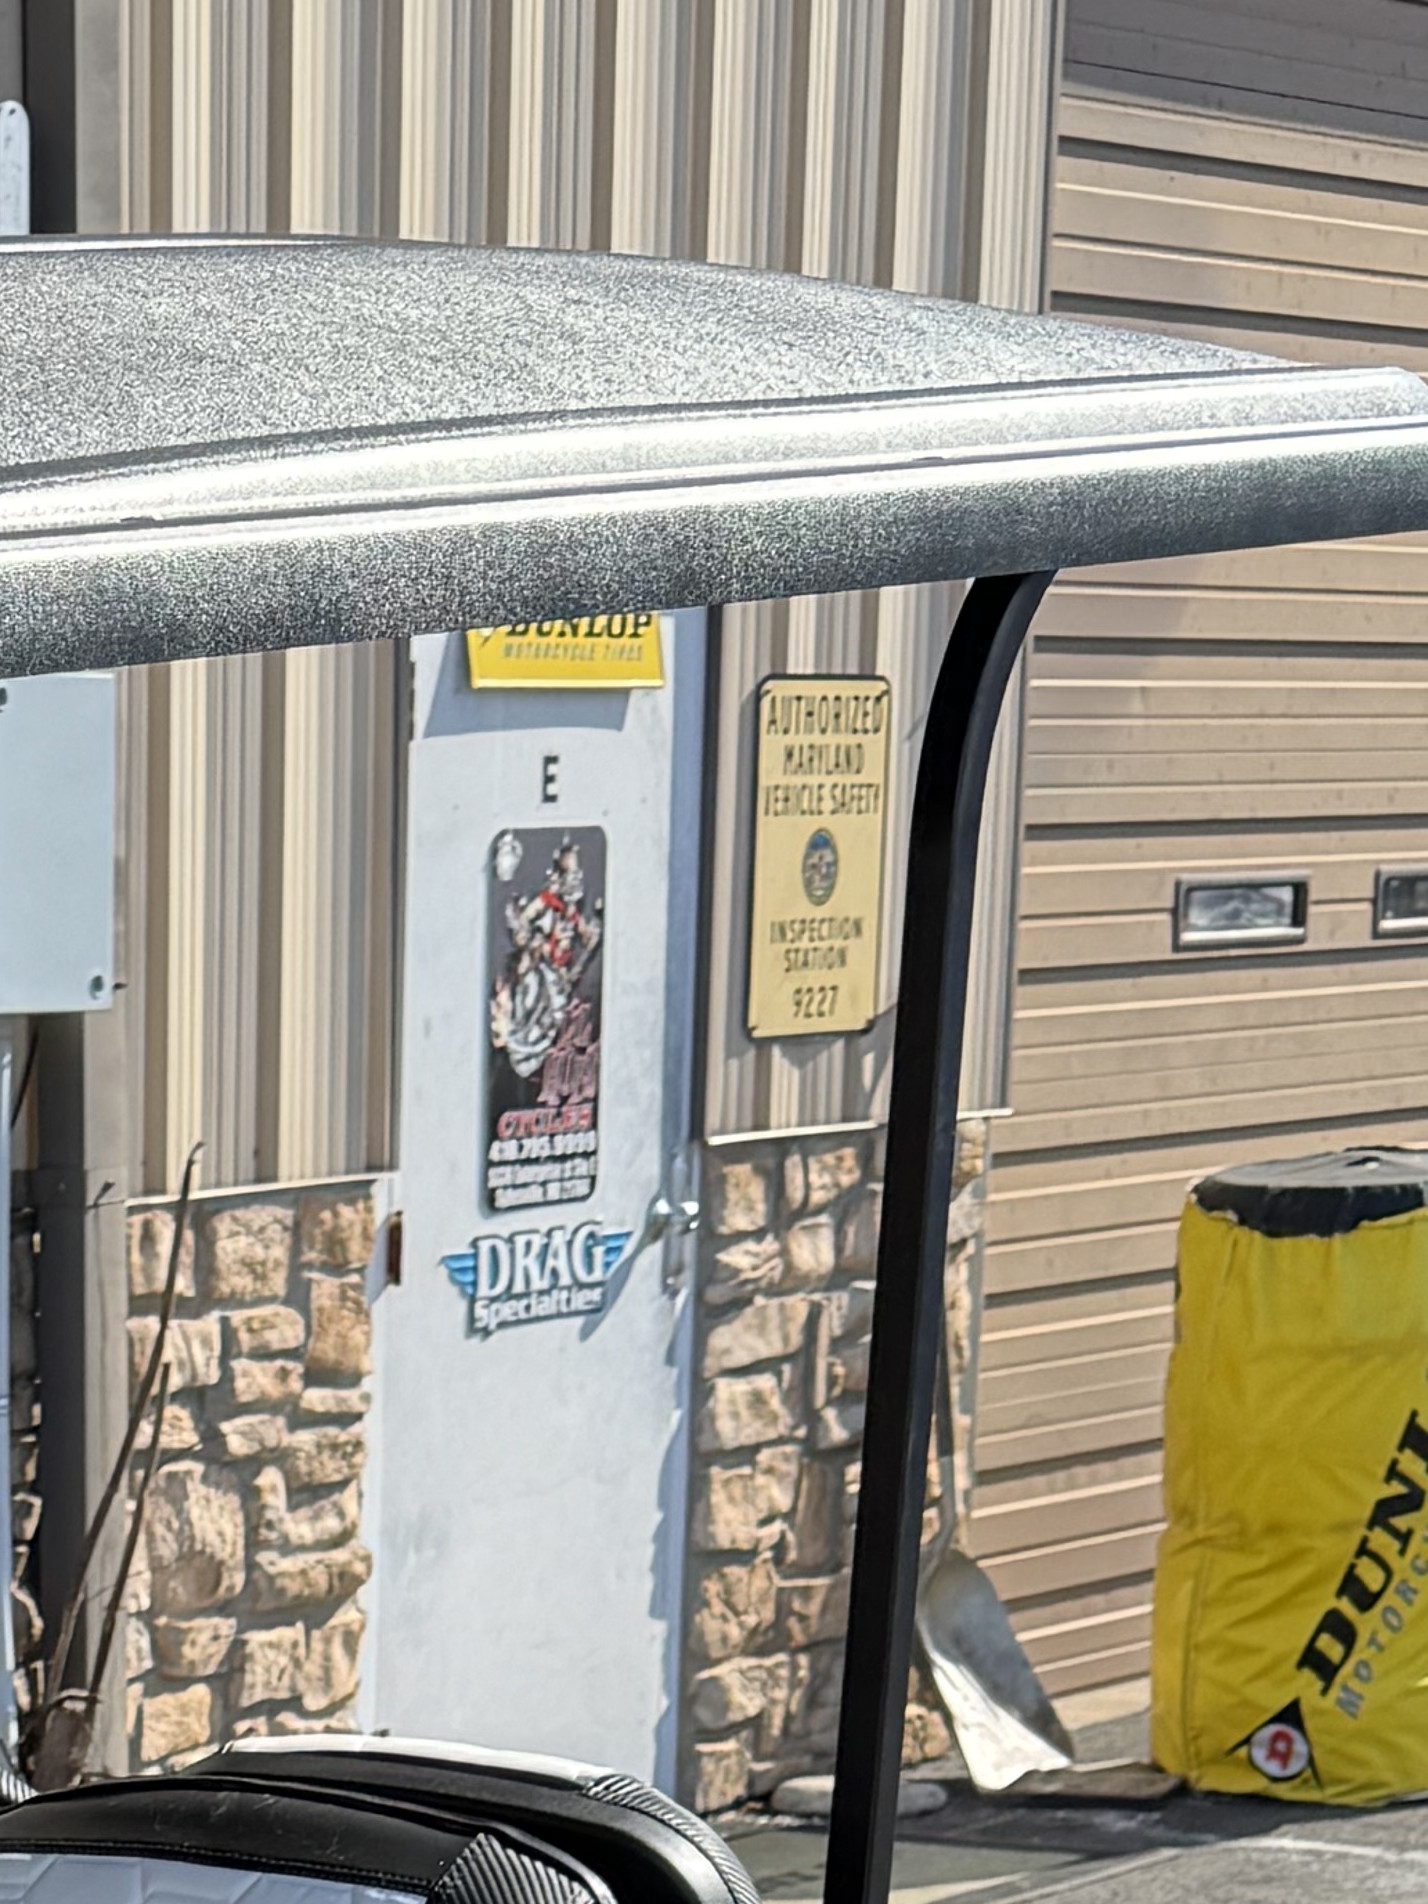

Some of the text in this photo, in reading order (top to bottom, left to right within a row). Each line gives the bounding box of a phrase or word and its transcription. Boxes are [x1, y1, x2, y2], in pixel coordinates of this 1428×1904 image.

[766, 694, 884, 735] AUTHORIZED
[782, 743, 866, 775] MARYLAND
[540, 755, 560, 804] E
[763, 782, 881, 817] VEHICLE SAFETY
[770, 916, 864, 945] INSPECTION
[784, 945, 848, 973] STATION
[793, 985, 839, 1019] 9227
[476, 1221, 607, 1299] DRAG
[474, 1285, 604, 1332] Specialties
